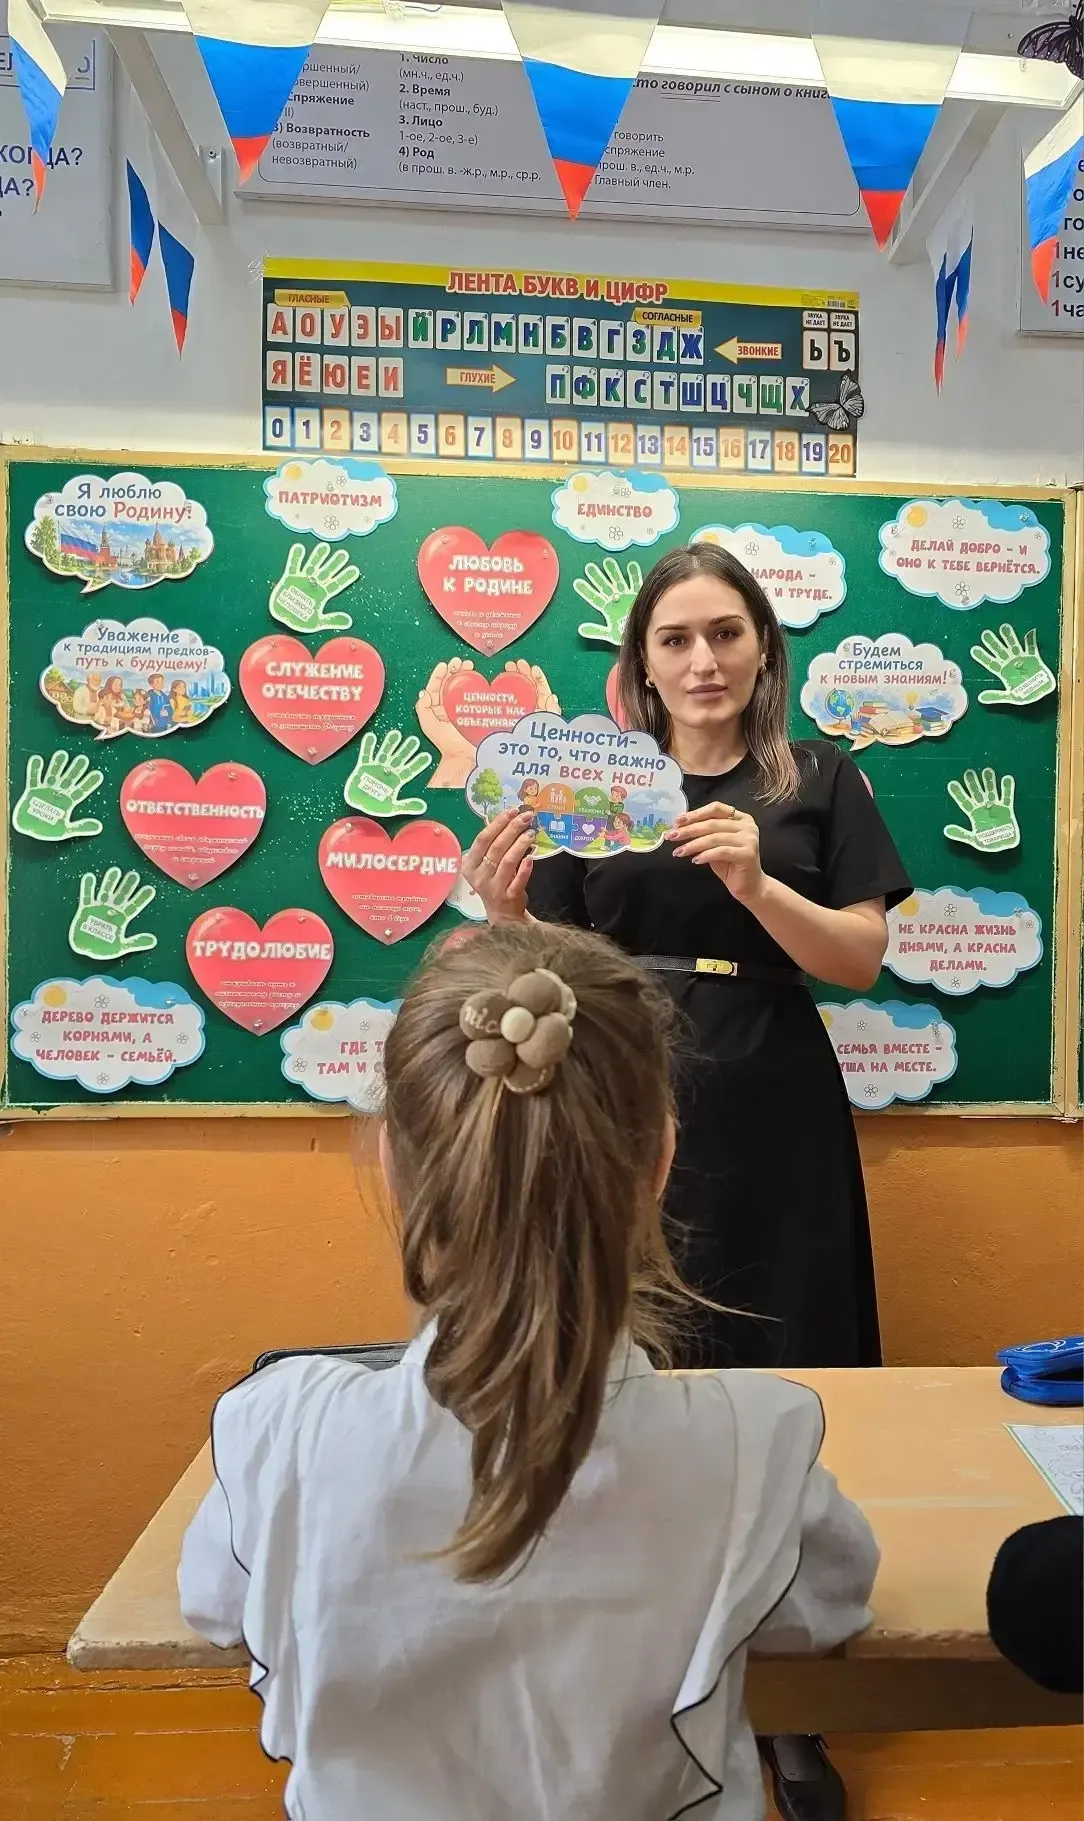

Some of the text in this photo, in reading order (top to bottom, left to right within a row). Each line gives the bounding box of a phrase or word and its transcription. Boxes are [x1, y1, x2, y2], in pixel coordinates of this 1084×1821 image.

[302, 63, 361, 75] ршенный/
[435, 71, 464, 83] ед.ч.)
[399, 83, 451, 97] 2. Время
[661, 80, 780, 96] говорил сыном
[399, 99, 499, 117] (наст., прош., буд.)
[399, 115, 443, 129] 3. Лицо
[286, 122, 370, 138] Возвратность
[614, 130, 664, 143] говорить
[272, 137, 349, 152] (возвратный/
[400, 130, 478, 146] 1-ое, 2-ое, 3-е)
[398, 146, 435, 160] 4) Род
[604, 146, 665, 158] спряжение
[272, 155, 357, 170] невозвратный)
[412, 164, 445, 175] прош.
[490, 169, 513, 180] м.р.,
[516, 170, 542, 182] ср.р.
[674, 166, 695, 177] м.р.
[595, 174, 671, 189] Главный член.
[448, 271, 668, 303] ЛЕНТА БУКВ И ЦИФР
[288, 293, 330, 304] ГЛАСНЫЕ
[642, 311, 693, 323] СОГЛАСНЫЕ
[271, 311, 401, 341] А О У Э Ы
[737, 345, 779, 357] ЗВОНКИЕ
[272, 355, 398, 391] Я Ё Ю Е И
[460, 371, 496, 384] ГЛУХИЕ
[271, 418, 851, 463] 0 1 2 3 4 5 6 7 8 9 10 11 12 13 14 15 16 17 18 19 20
[78, 483, 162, 499] Я люблю
[278, 491, 382, 508] ПАТРИОТИЗМ
[55, 501, 192, 524] свою Родину!
[577, 503, 653, 518] ЕДИНСТВО
[911, 539, 1027, 556] ДЕЛАЙ ДОБРО И
[448, 555, 524, 572] ЛЮБОВЬ
[896, 557, 1041, 574] ОНО К ТЕБЕ ВЕРНЁТСЯ.
[751, 567, 803, 582] НАРОДА
[442, 577, 533, 596] К РОДИНЕ
[775, 588, 783, 597] И
[789, 588, 833, 601] ТРУДЕ.
[98, 627, 180, 643] Уважение
[64, 642, 215, 658] к традициям предков-
[853, 642, 901, 659] Будем
[75, 656, 208, 671] путь к будущему!
[265, 661, 364, 679] СЛУЖЕНИЕ
[839, 660, 923, 673] стремиться
[820, 671, 947, 684] к новым знаниям!
[262, 682, 363, 701] ОТЕЧЕСТВУ
[463, 692, 518, 703] ЦЕННОСТИ,
[455, 705, 526, 716] КОТОРЫЕ НАС
[530, 721, 637, 748] Ценности-
[498, 742, 666, 771] это то, что важно
[512, 762, 654, 787] для всех нас!
[126, 799, 265, 819] ОТВЕТСТВЕННОСТЬ
[325, 852, 458, 875] МИЛОСЕРДИЕ
[898, 923, 1017, 936] НЕ КРАСНА ЖИЗНЬ
[192, 940, 332, 961] ТРУДОЛЮБИЕ
[898, 942, 1017, 954] ДНЯМИ, А КРАСНА
[929, 960, 987, 971] ДЕЛАМИ.
[41, 1010, 174, 1025] ДЕРЕВО ДЕРЖИТСЯ
[63, 1030, 152, 1044] КОРНЯМИ, А
[35, 1048, 177, 1063] ЧЕЛОВЕК СЕМЬЁЙ.
[340, 1041, 368, 1055] ГДЕ
[837, 1043, 930, 1055] СЕМЬЯ ВМЕСТЕ
[317, 1062, 349, 1074] ТАМ
[356, 1062, 367, 1073] И
[839, 1061, 937, 1073] УША НА МЕСТЕ.
